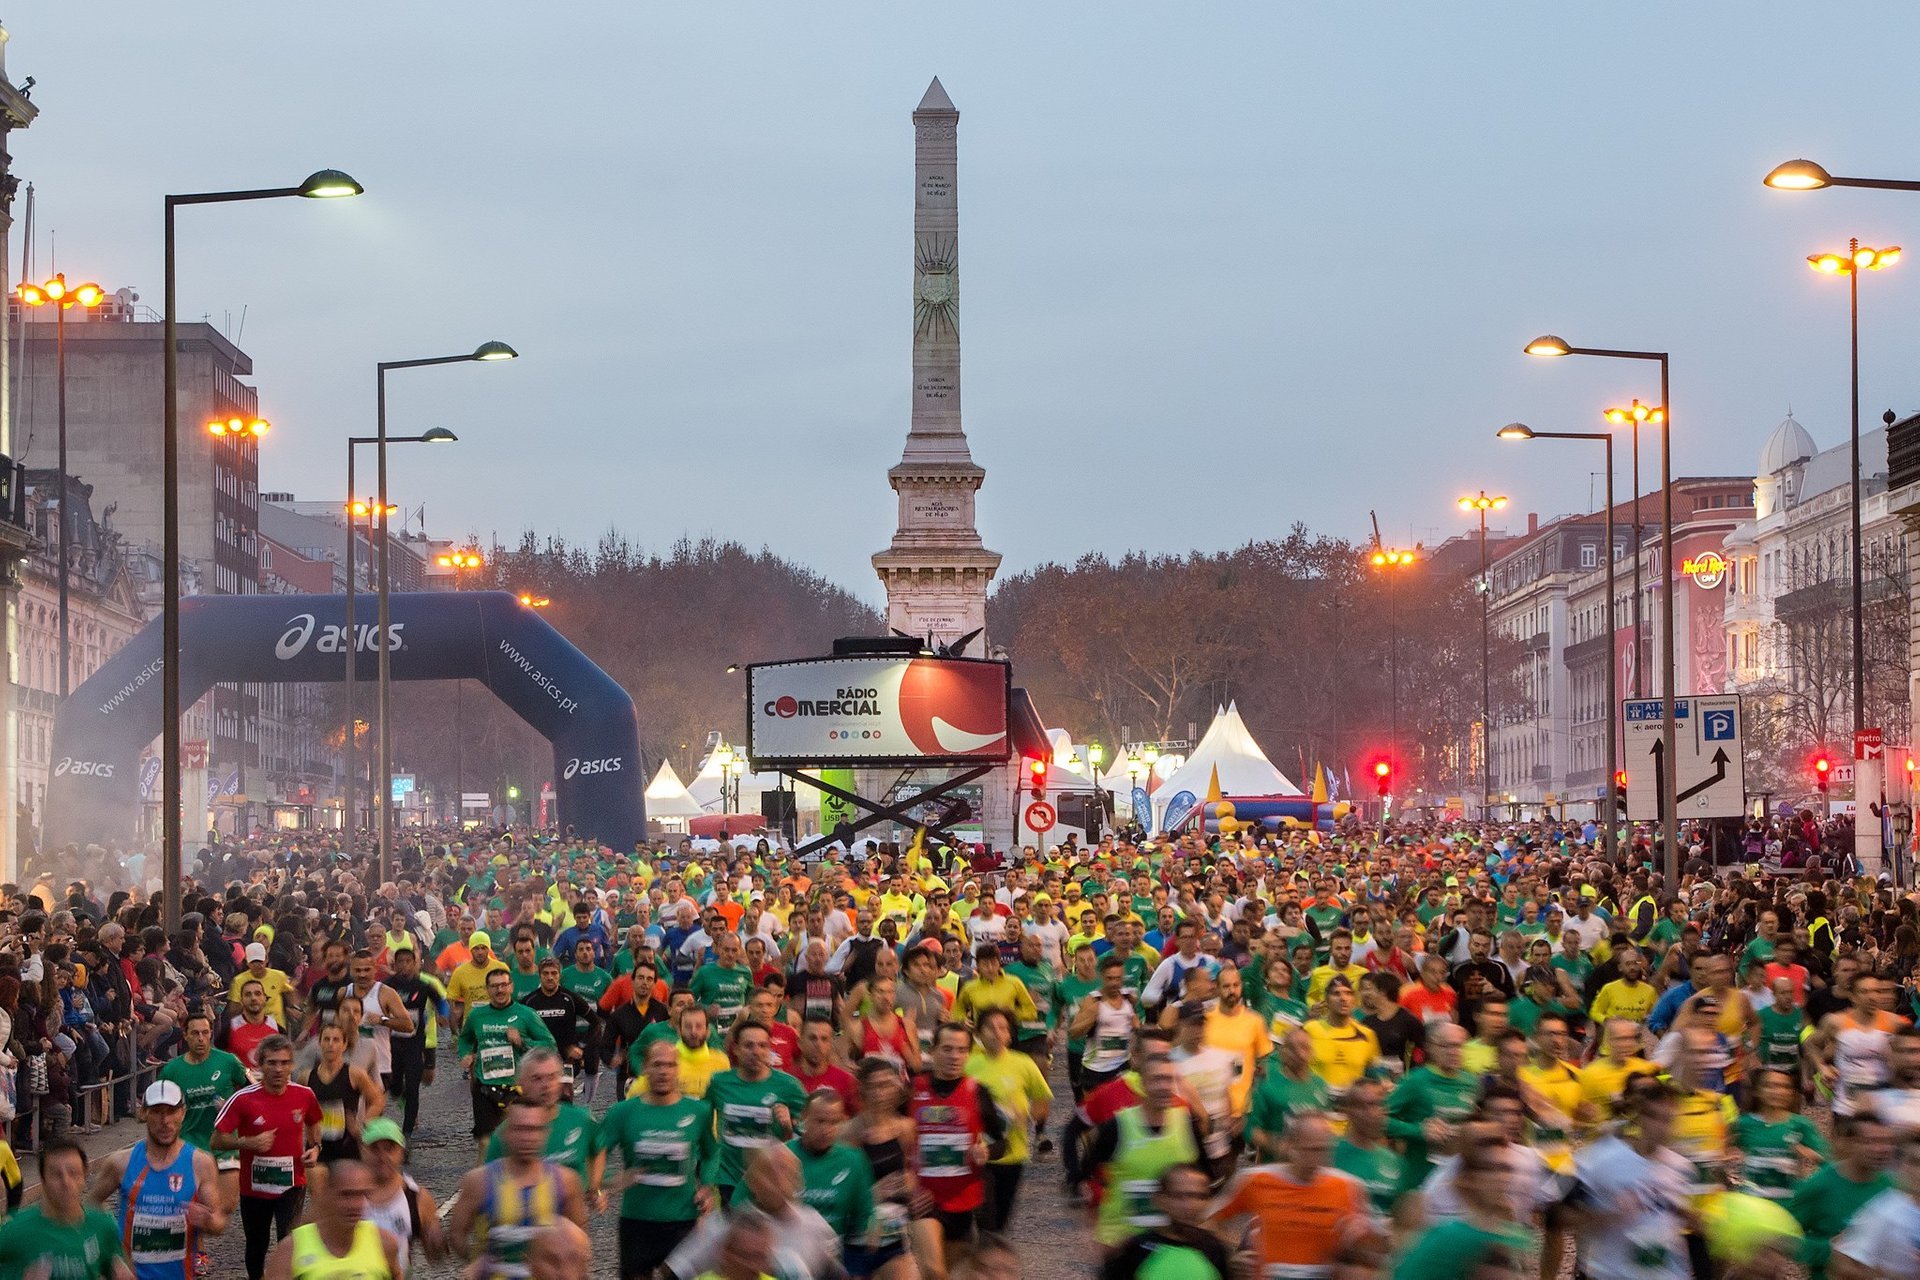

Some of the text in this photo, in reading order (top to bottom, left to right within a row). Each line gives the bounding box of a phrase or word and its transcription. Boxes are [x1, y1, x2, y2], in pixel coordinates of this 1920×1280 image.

[316, 623, 405, 653] asics
[499, 639, 578, 715] www.asics.pt
[836, 686, 878, 700] RÁDIO
[763, 695, 882, 719] COMERCIAL
[1645, 703, 1656, 711] A1
[1645, 711, 1657, 719] A2
[70, 761, 114, 778] asics
[580, 757, 622, 775] asics
